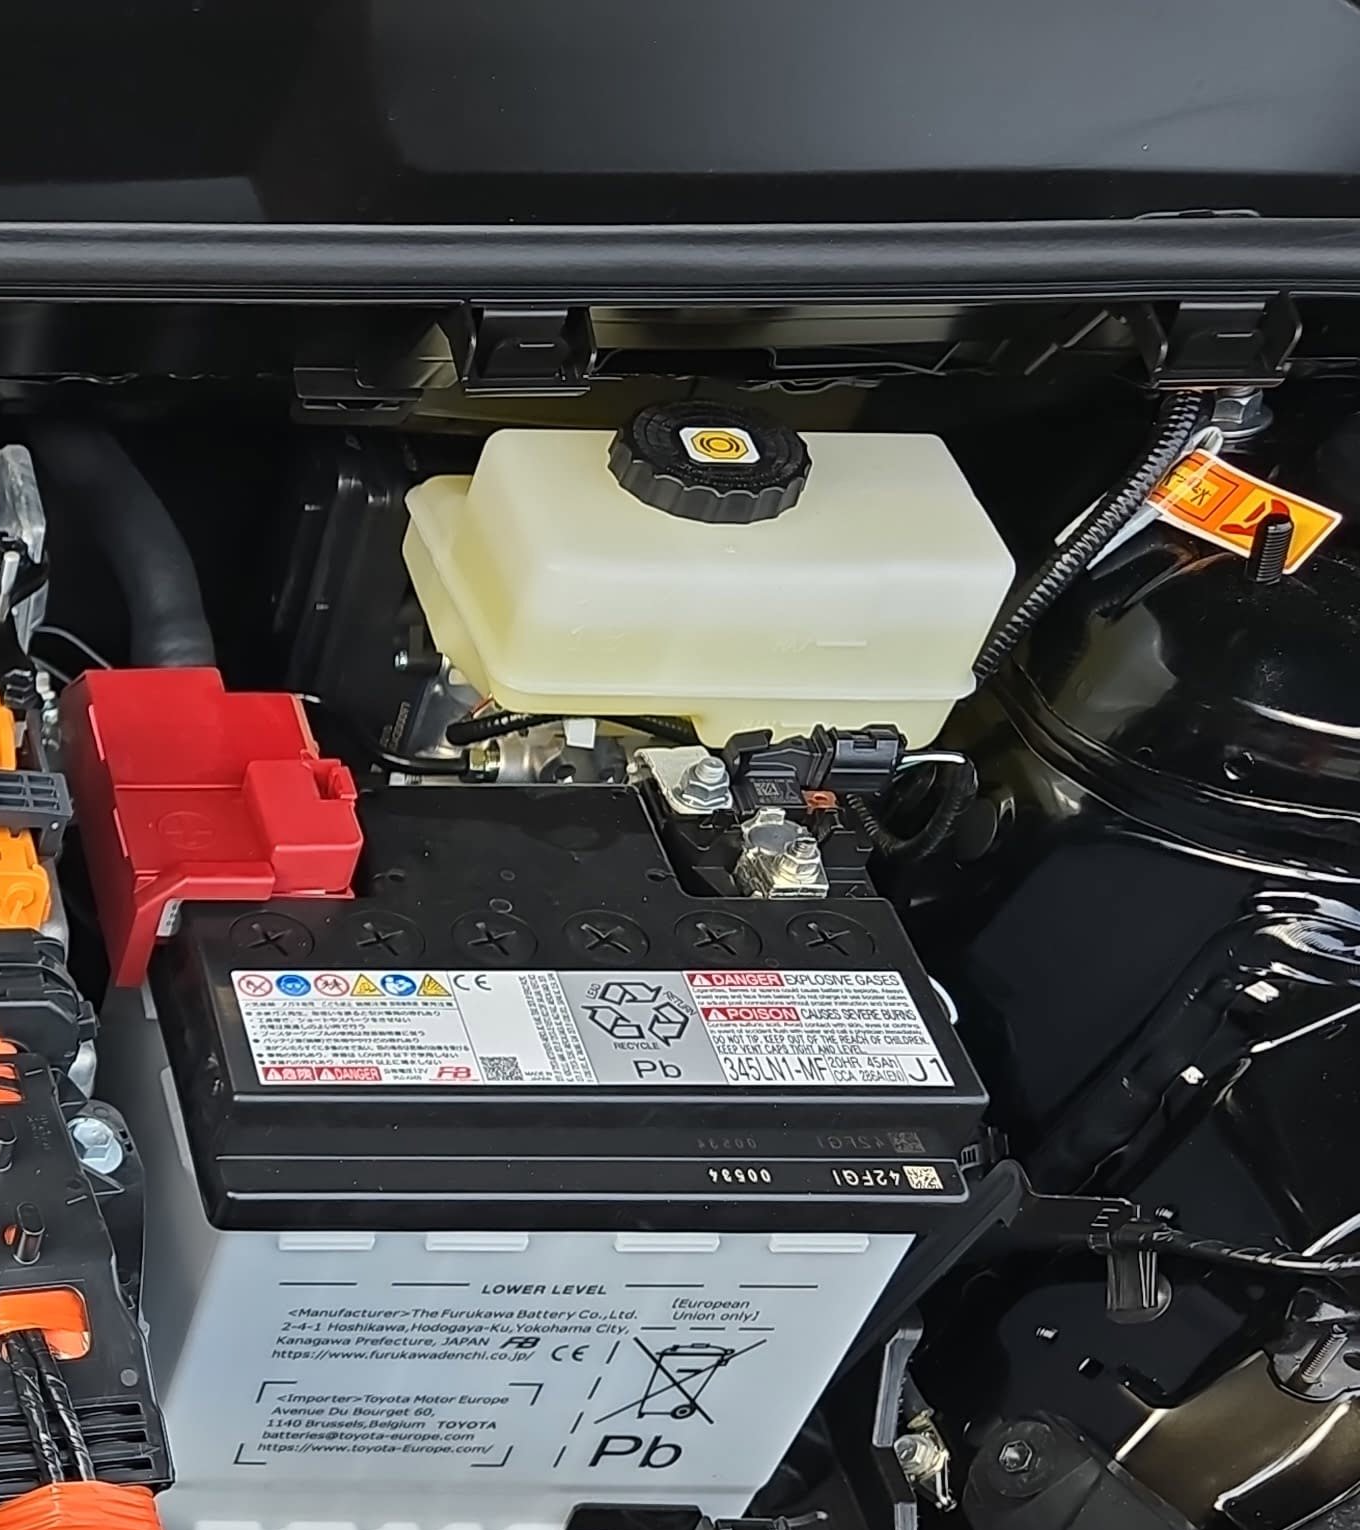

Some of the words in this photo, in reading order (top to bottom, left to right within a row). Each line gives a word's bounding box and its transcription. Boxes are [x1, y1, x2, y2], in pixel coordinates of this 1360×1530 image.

[712, 975, 781, 985] DANGER
[784, 975, 854, 986] EXPLOSIVE
[855, 975, 900, 986] GASES
[726, 1009, 797, 1020] POISON
[800, 1008, 841, 1020] CAUSES
[842, 1009, 880, 1020] SEVERE
[881, 1009, 917, 1020] BURNS
[713, 1035, 725, 1044] DO
[728, 1035, 745, 1044] NOT
[764, 1035, 784, 1044] KEEP
[787, 1035, 805, 1044] OUT
[807, 1035, 818, 1044] OF
[821, 1035, 836, 1044] THE
[840, 1035, 869, 1044] REACH
[870, 1035, 881, 1044] OF
[614, 1042, 660, 1050] RECYCLE
[715, 1045, 738, 1054] KEEP
[742, 1045, 763, 1054] VENT
[765, 1045, 788, 1054] CAPS
[790, 1045, 816, 1054] TIGHT
[818, 1045, 836, 1054] AND
[828, 1057, 862, 1068] 20HR
[867, 1057, 898, 1068] 45Ah
[335, 1068, 379, 1080] DANGER
[633, 1060, 682, 1078] Pb
[723, 1057, 827, 1081] 345LN1-MF
[833, 1070, 856, 1081] CCA
[481, 1284, 546, 1295] LOWER
[551, 1285, 607, 1295] LEVEL
[441, 1309, 514, 1320] Furukawa
[517, 1310, 575, 1321] Battery
[579, 1310, 637, 1321] Co.,Ltd.
[672, 1311, 718, 1321] Union
[281, 1322, 321, 1332] 2-4-1
[596, 1324, 629, 1335] City,
[276, 1337, 351, 1347] Kanagawa
[355, 1337, 436, 1348] Prefecture,
[442, 1337, 490, 1347] JAPAN
[272, 1350, 534, 1362] https://www.furukawadenchi.co.jp/
[413, 1394, 456, 1404] Motor
[458, 1395, 509, 1405] Europe
[271, 1407, 325, 1416] Avenue
[328, 1407, 348, 1416] Du
[353, 1407, 409, 1417] Bourget
[414, 1407, 435, 1417] 60,
[266, 1419, 301, 1428] 1140
[304, 1419, 426, 1431] Brussels,Belgium
[437, 1421, 496, 1429] TOYOTA
[262, 1431, 474, 1442] batteries@toyota-europe.com
[588, 1435, 682, 1469] Pb
